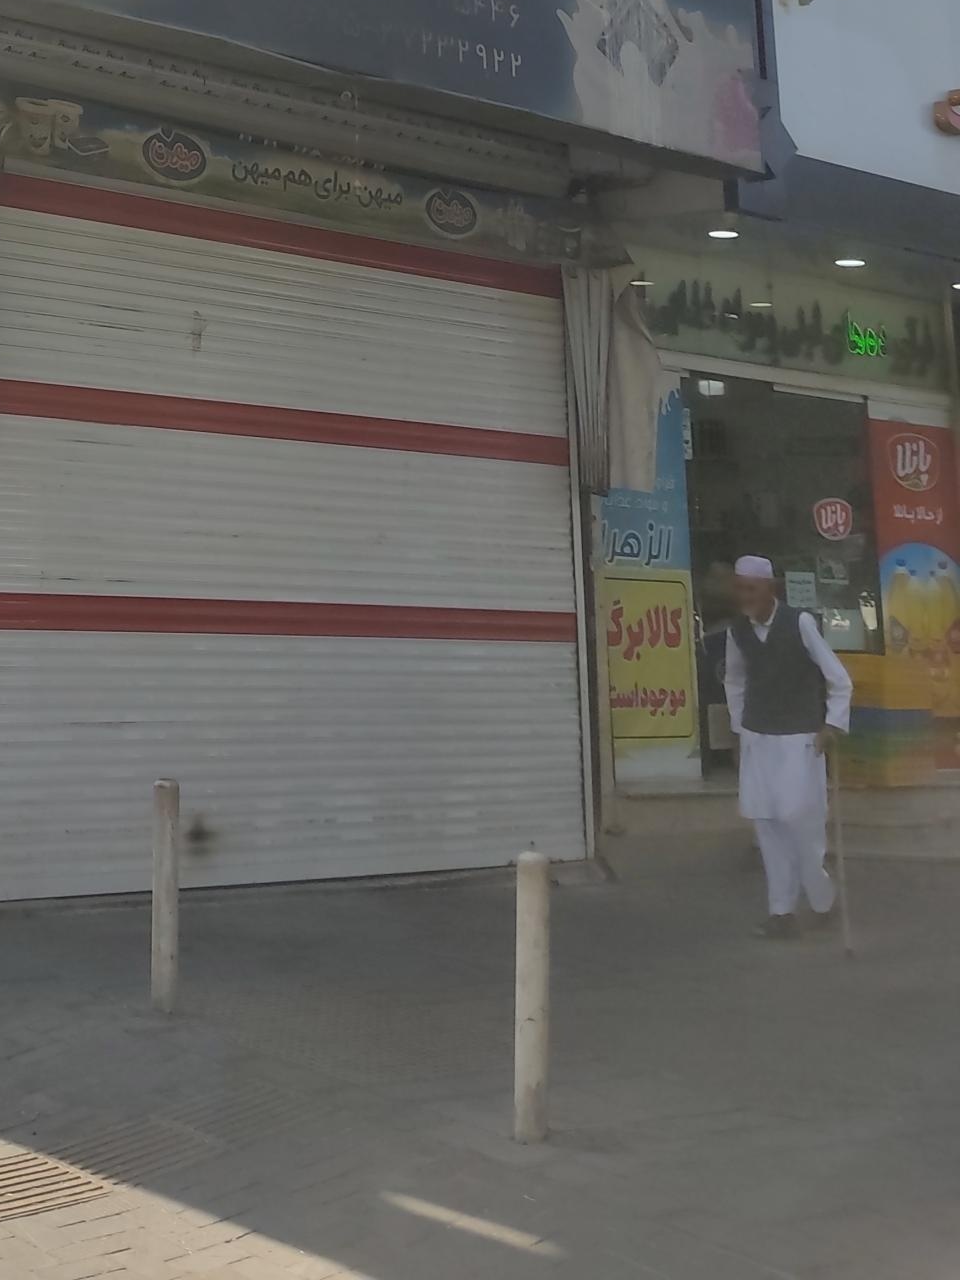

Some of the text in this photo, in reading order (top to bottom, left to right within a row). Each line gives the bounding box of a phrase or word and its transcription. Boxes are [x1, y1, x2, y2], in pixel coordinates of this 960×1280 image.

[314, 171, 351, 202] برای
[358, 185, 403, 210] میهن
[601, 519, 673, 569] الزهرا
